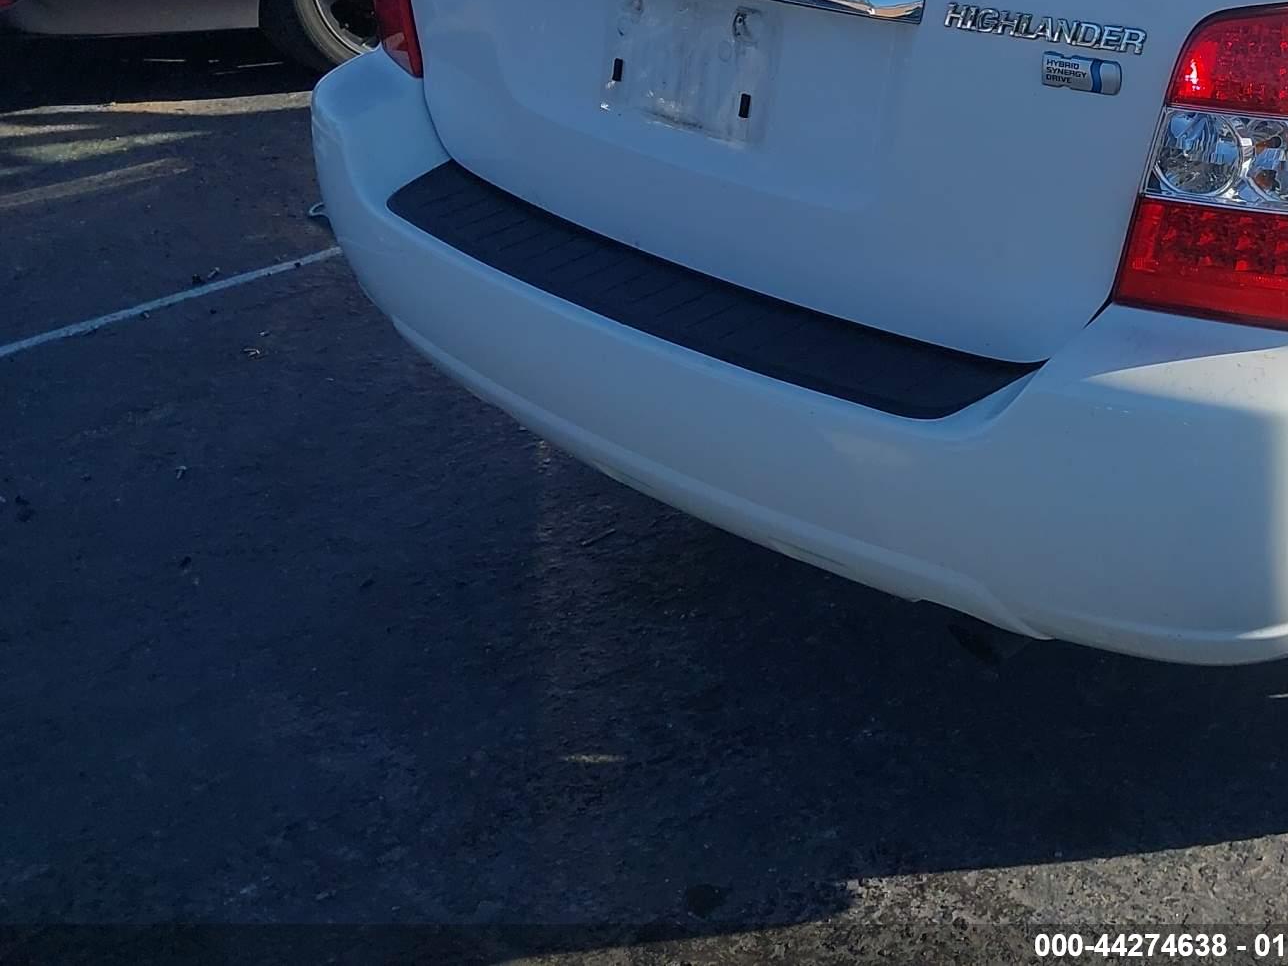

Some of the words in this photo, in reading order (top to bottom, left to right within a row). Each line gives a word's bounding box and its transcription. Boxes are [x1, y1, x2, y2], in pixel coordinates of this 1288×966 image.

[944, 2, 1148, 55] HIGHLANDER
[1046, 58, 1080, 70] HYBRID
[1046, 66, 1087, 79] SYNERGY
[1045, 74, 1073, 84] DRIVE
